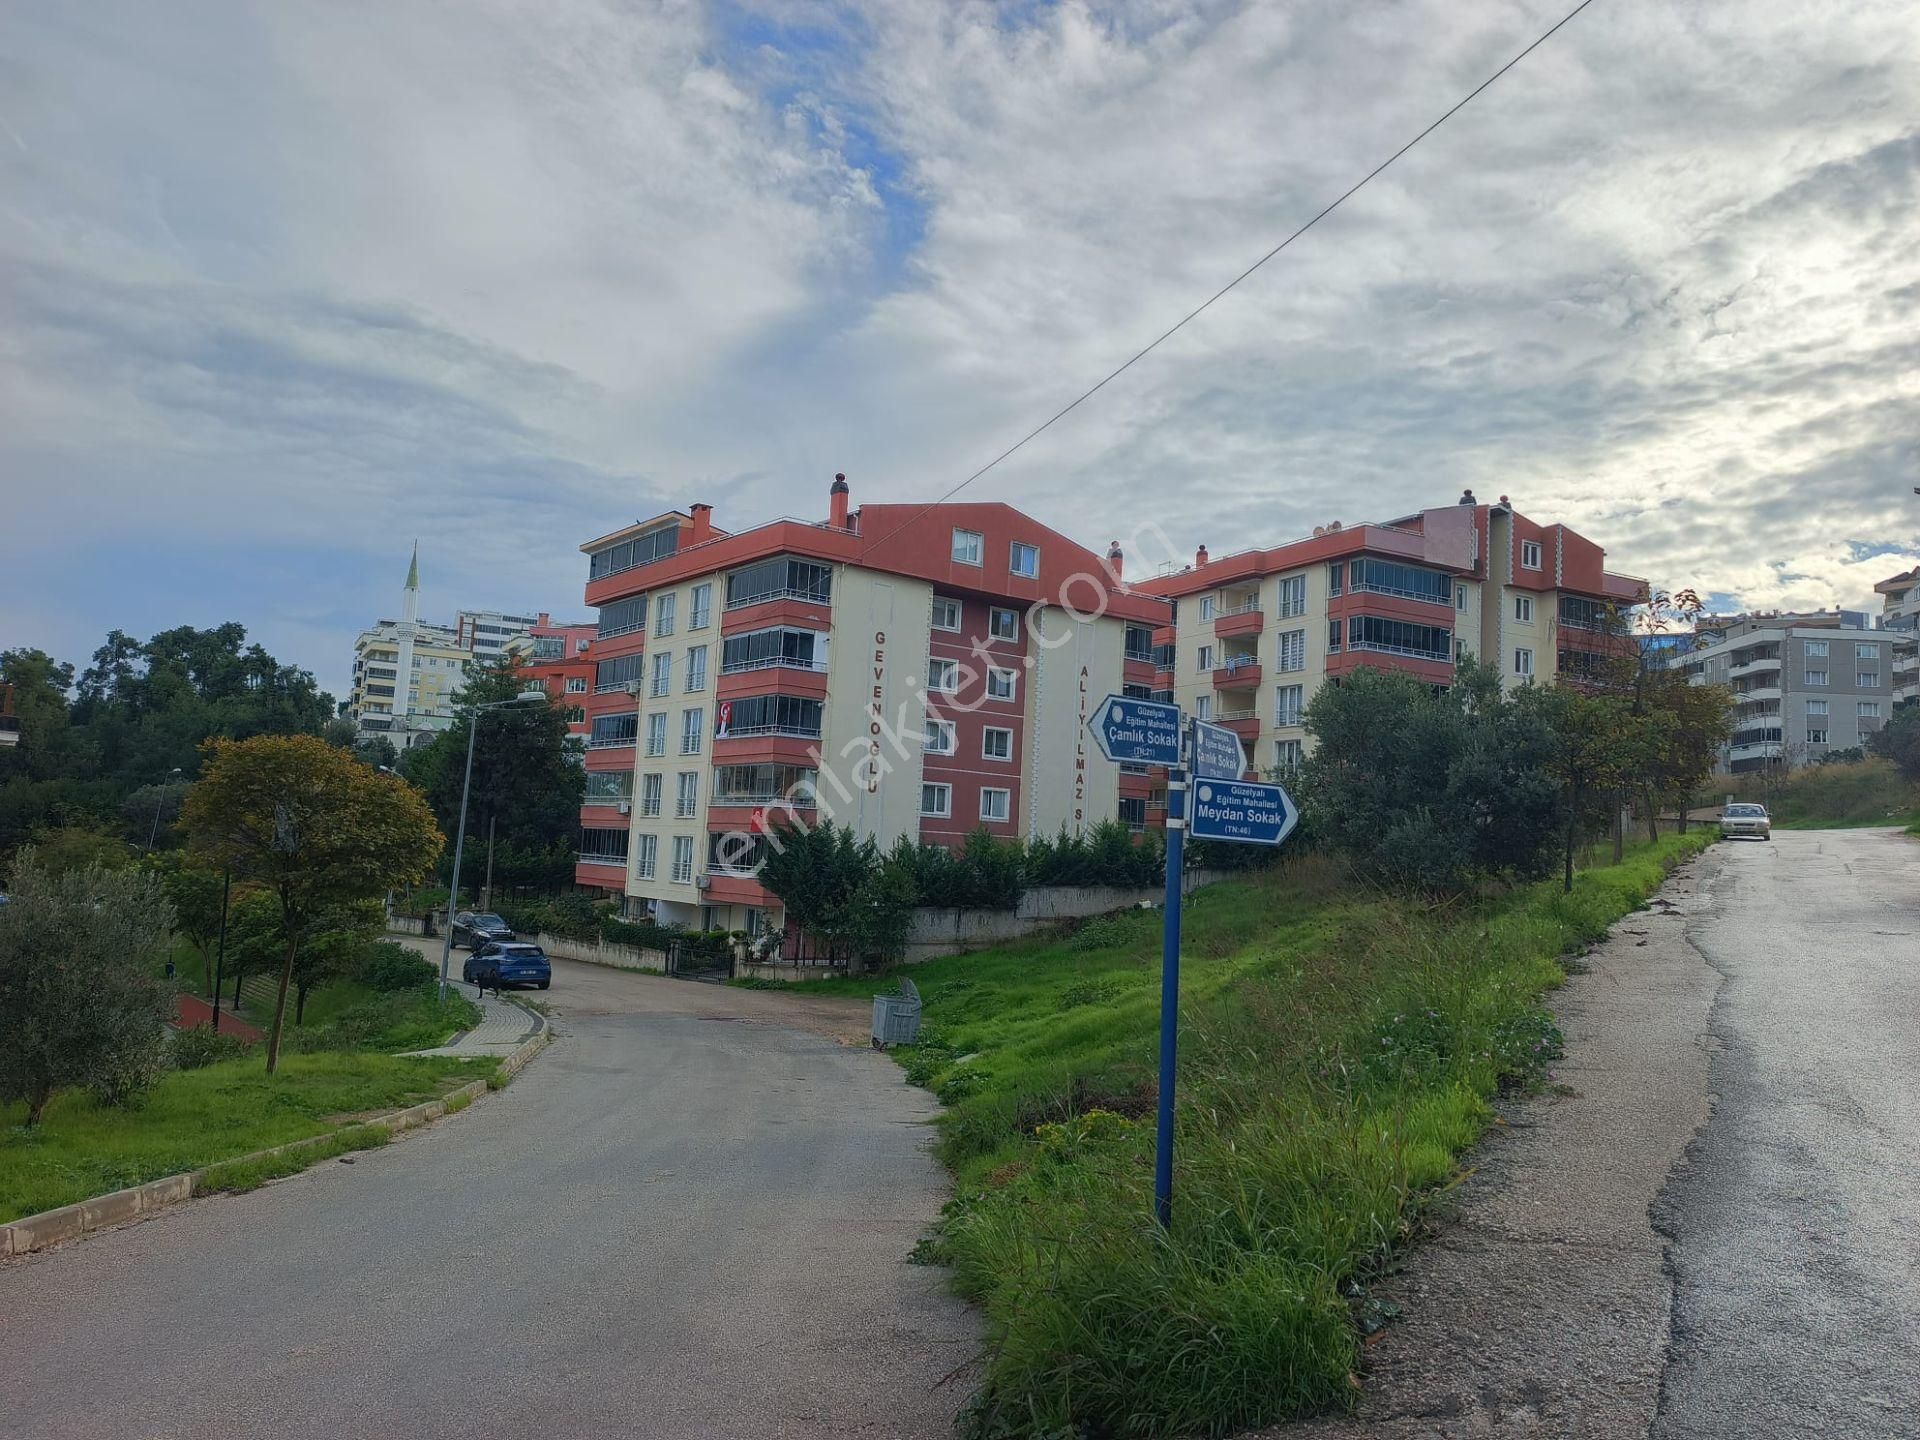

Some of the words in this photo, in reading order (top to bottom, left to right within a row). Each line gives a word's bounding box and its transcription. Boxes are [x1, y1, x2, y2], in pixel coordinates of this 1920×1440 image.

[867, 631, 886, 793] GEVENOĞLU
[1126, 715, 1147, 727] Eğitim
[1147, 718, 1176, 731] Mahallesi
[1109, 726, 1145, 743] Çamlık
[1147, 731, 1177, 747] Sokak
[1216, 794, 1242, 806] Eğitim
[1242, 797, 1278, 809] Mahallesi
[1231, 786, 1266, 799] Güzelyalı
[1198, 804, 1244, 822] Meydan
[1247, 809, 1282, 825] Sokak
